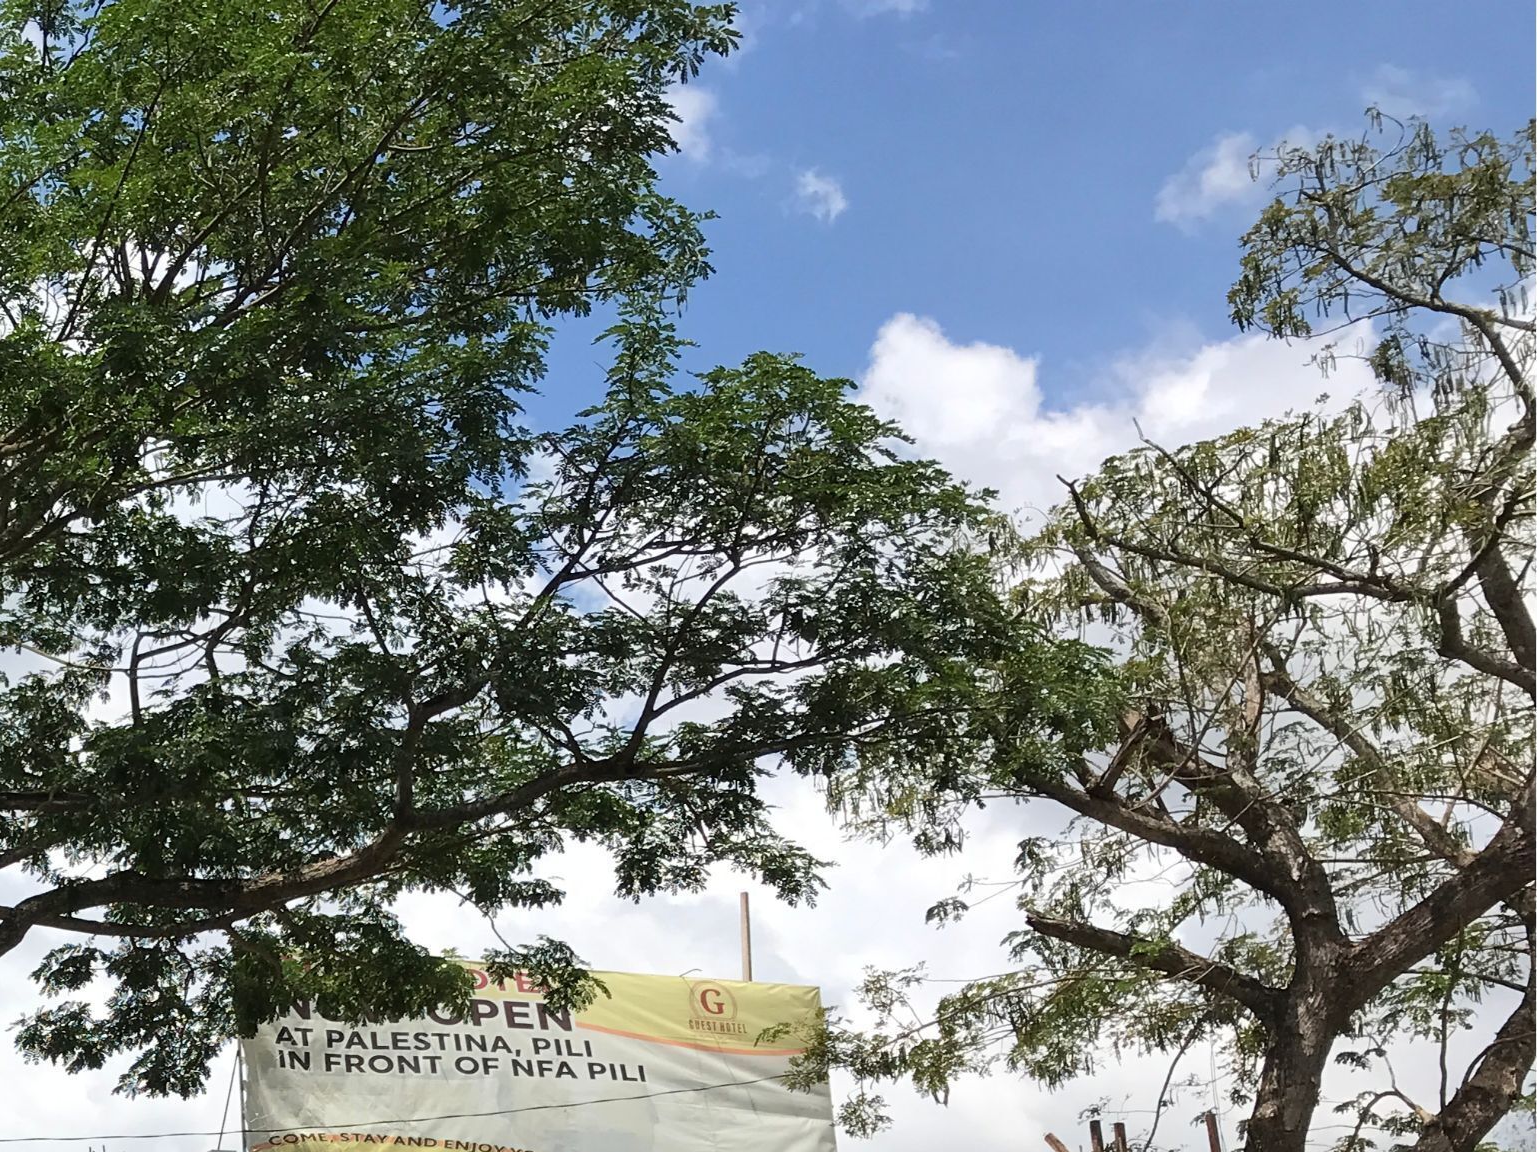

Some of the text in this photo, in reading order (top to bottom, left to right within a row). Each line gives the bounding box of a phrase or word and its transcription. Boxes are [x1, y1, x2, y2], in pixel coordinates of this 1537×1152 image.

[699, 988, 726, 1015] G
[688, 1019, 748, 1034] GUEST HOTEL
[275, 1026, 592, 1057] AT PALESTINA, PILI
[278, 1050, 647, 1083] IN FRONT OF NFA PILI
[268, 1132, 334, 1145] COME,
[340, 1132, 387, 1144] STAY
[394, 1136, 437, 1147] AND
